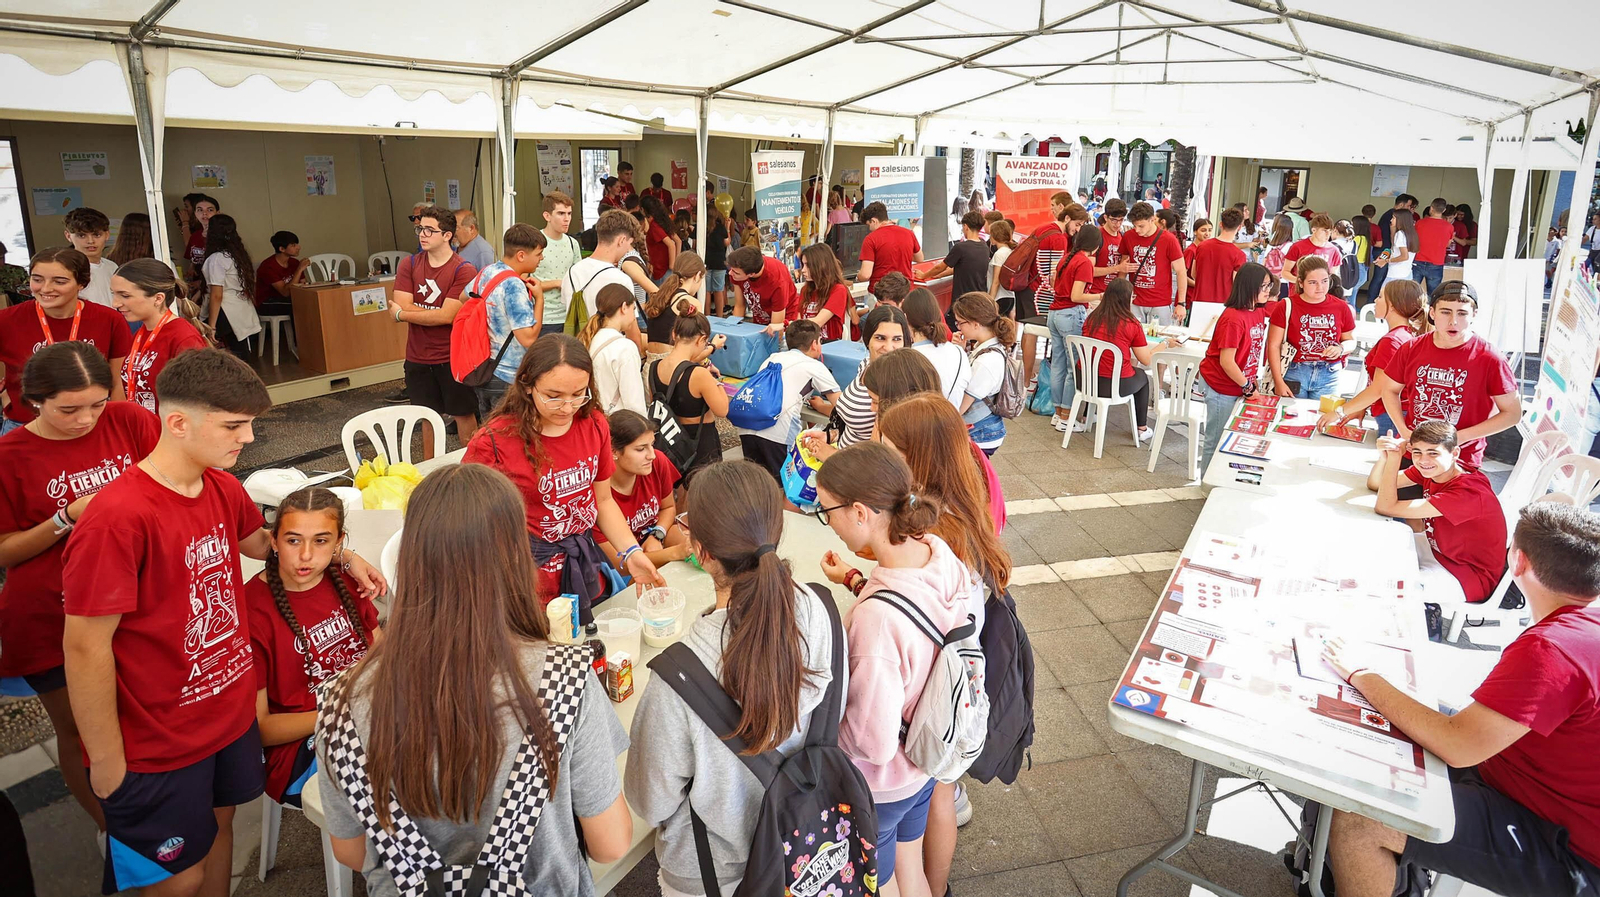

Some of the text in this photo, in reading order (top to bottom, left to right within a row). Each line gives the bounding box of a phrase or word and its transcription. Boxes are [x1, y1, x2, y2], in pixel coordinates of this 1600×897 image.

[770, 160, 796, 168] salesianos
[1005, 160, 1068, 170] AVANZANDO
[1427, 370, 1454, 382] CIENCIA
[70, 467, 120, 492] CIENCIA
[555, 469, 590, 490] CIENCIA
[310, 617, 348, 646] CIENCIA
[810, 853, 829, 874] VANS
[815, 863, 831, 880] THE
